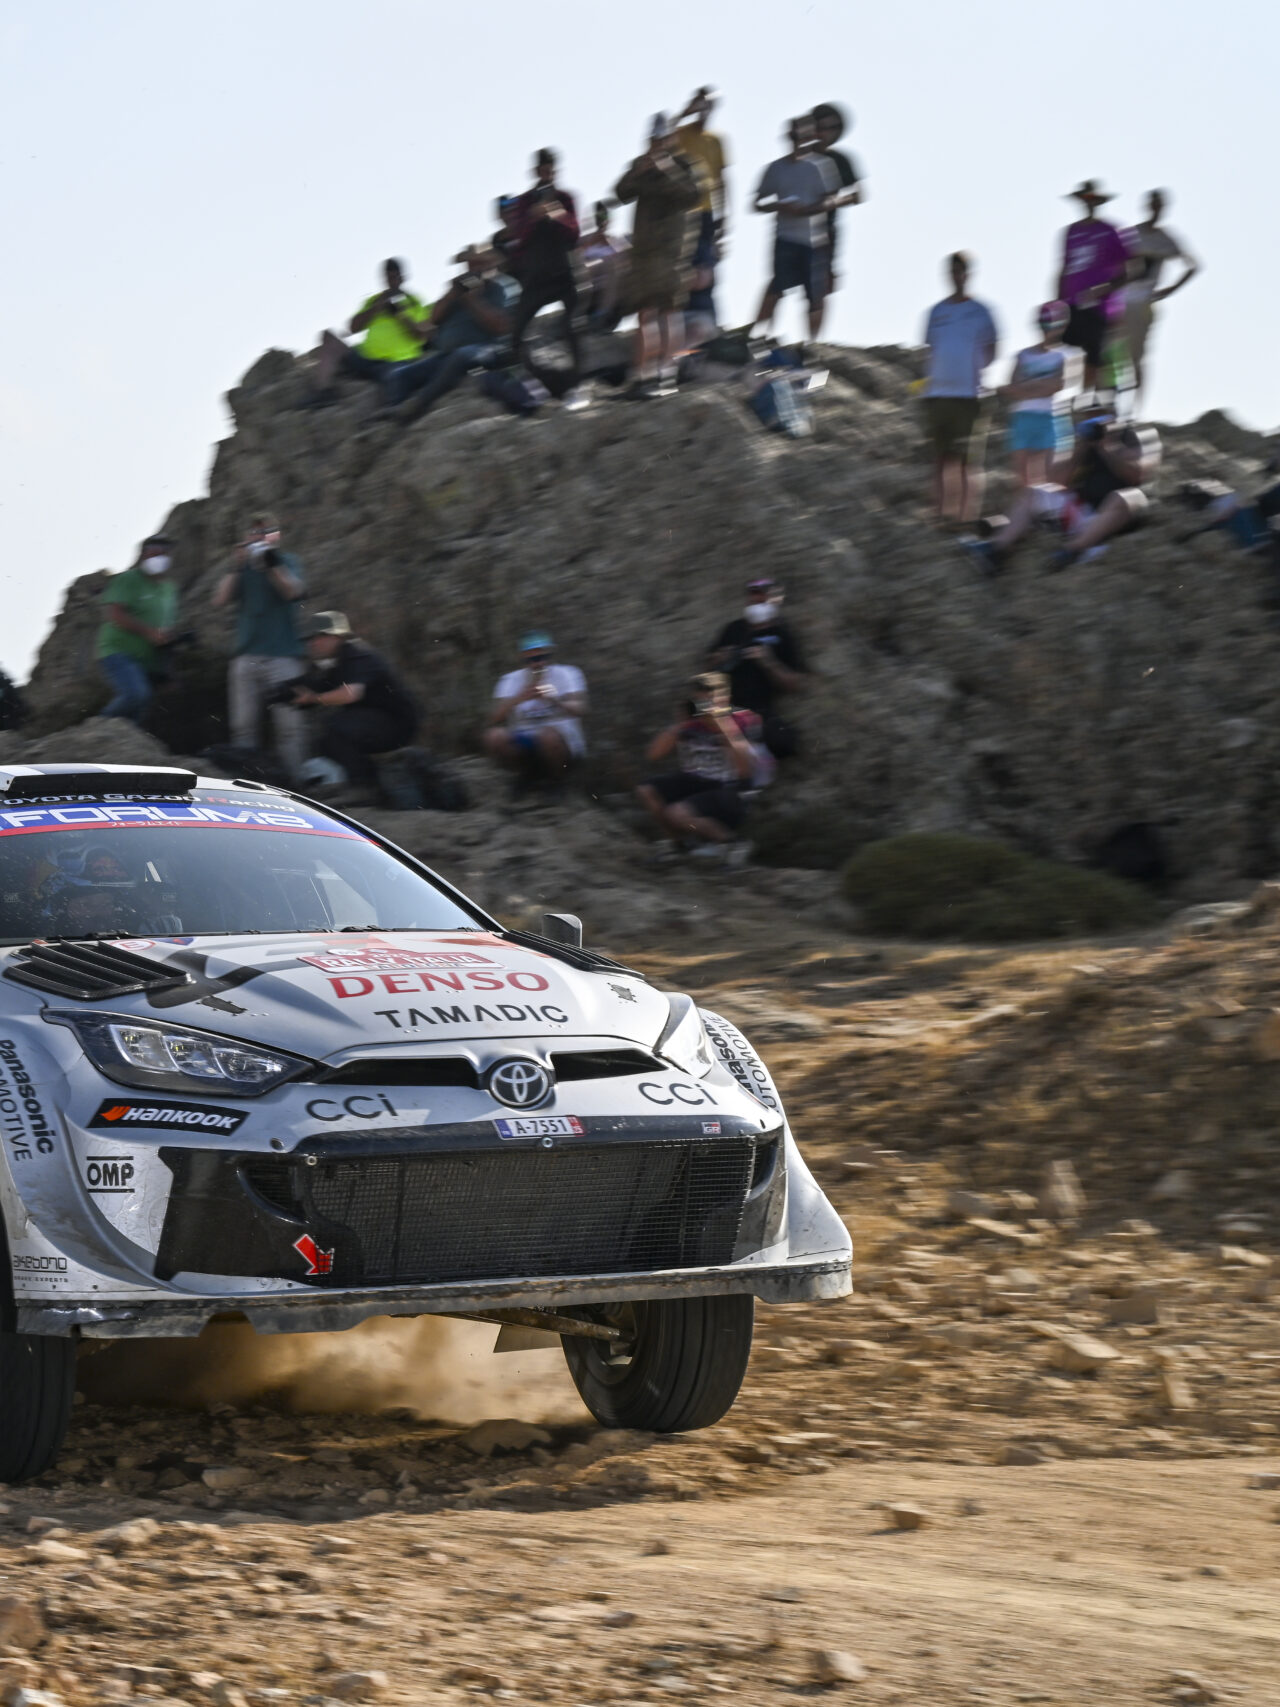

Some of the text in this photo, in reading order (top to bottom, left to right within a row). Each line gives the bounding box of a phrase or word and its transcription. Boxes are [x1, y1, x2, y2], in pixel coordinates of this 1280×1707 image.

[207, 796, 296, 813] Racing
[0, 805, 314, 829] FORUM8
[323, 957, 397, 968] RALLY
[407, 954, 484, 965] ITALIA
[326, 971, 549, 999] DENSO
[374, 1004, 569, 1028] TAMADIC
[706, 1014, 781, 1114] UTOMOTIVE
[514, 1119, 568, 1134] A-7551
[87, 1162, 135, 1187] OMP
